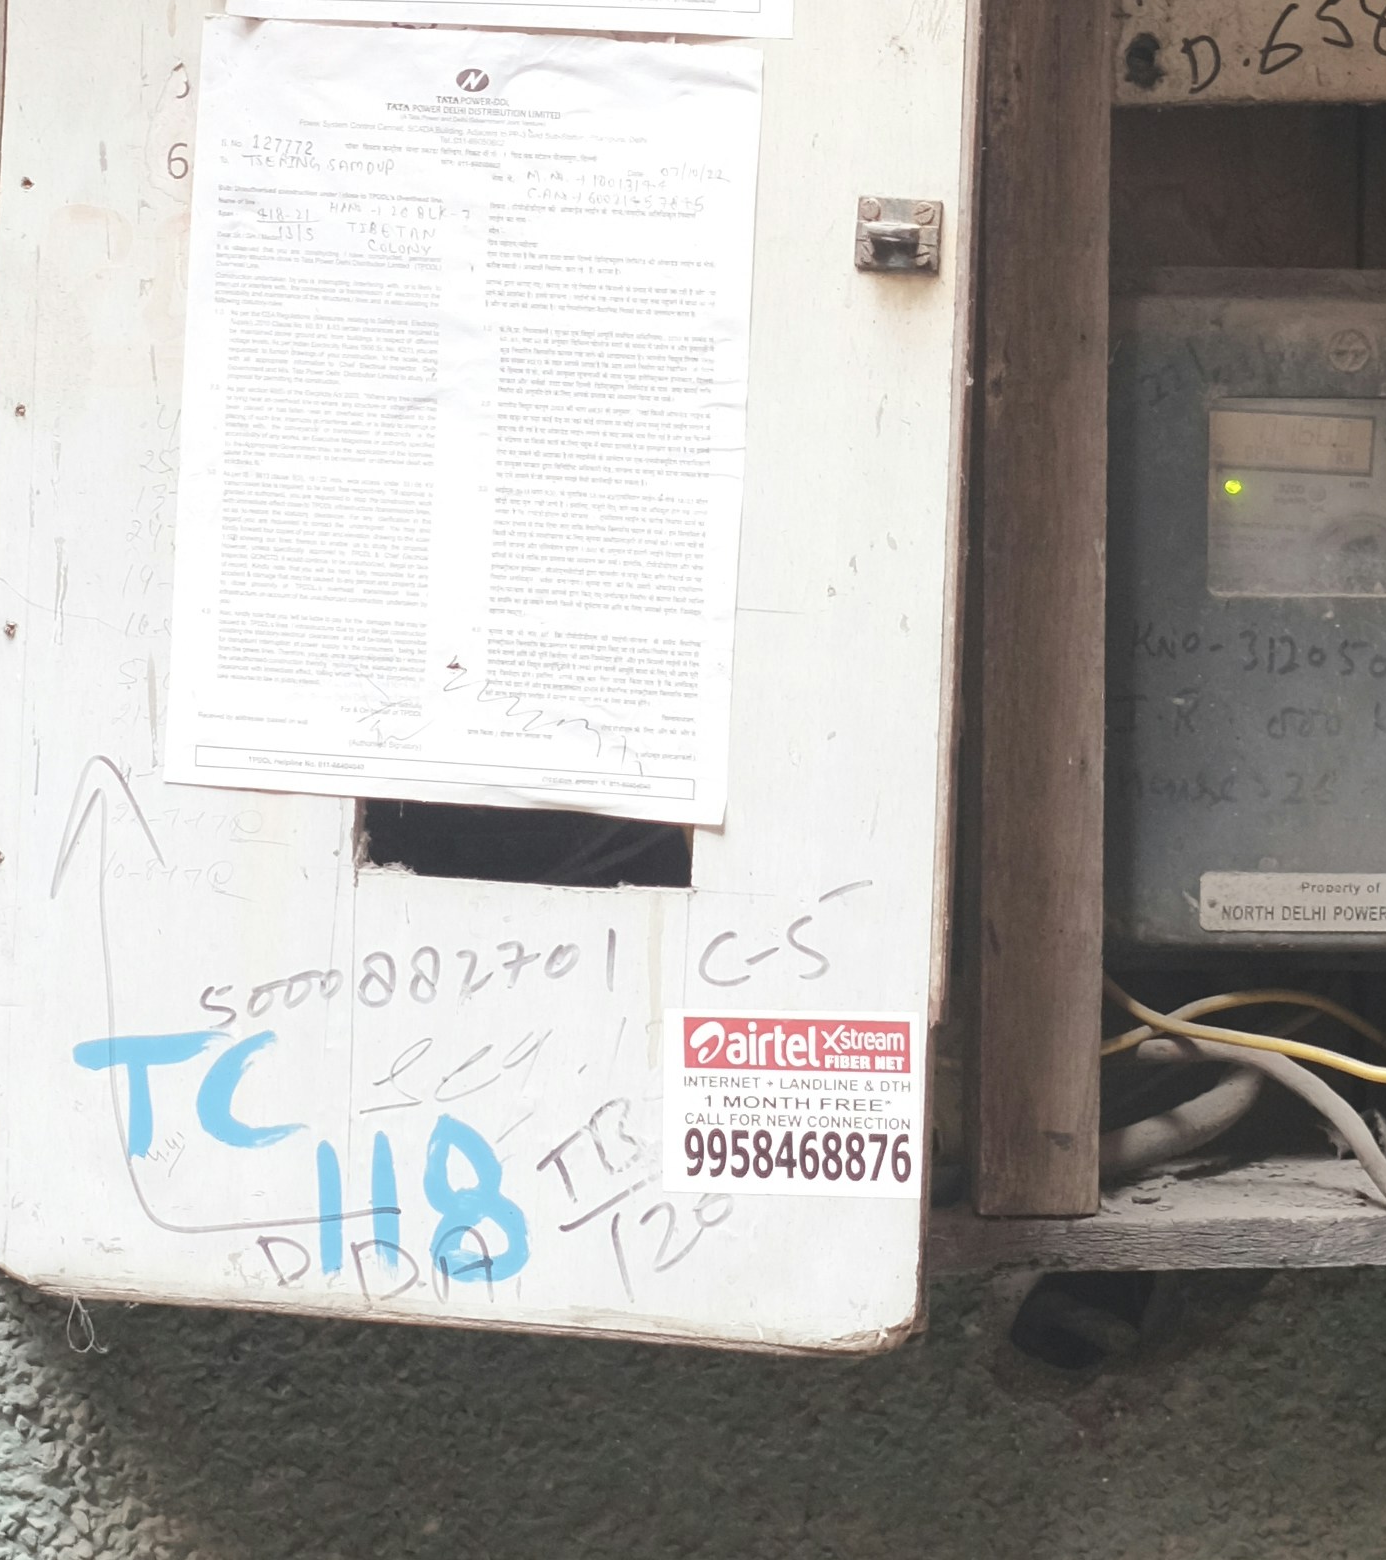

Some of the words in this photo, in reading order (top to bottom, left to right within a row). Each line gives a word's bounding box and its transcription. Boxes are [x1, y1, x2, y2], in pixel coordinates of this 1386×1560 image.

[436, 95, 459, 104] TATA
[386, 102, 410, 112] TATA
[412, 104, 441, 114] POWER
[443, 105, 466, 115] DELHI
[468, 107, 527, 117] DISTRIBUTION
[528, 110, 561, 120] LIMITED
[251, 134, 314, 156] 127772
[166, 141, 190, 180] 6
[346, 221, 436, 240] TIBETAN
[367, 239, 432, 256] COLONY
[1300, 881, 1361, 896] Property
[1366, 881, 1381, 894] of
[1221, 905, 1275, 921] NORTH
[1281, 906, 1327, 921] DELHI
[201, 927, 617, 1030] 5000882701
[725, 1021, 821, 1069] airtel
[821, 1024, 905, 1055] Xstream
[824, 1054, 871, 1070] FIBER
[875, 1055, 905, 1071] NET
[683, 1075, 761, 1089] INTERNET
[779, 1078, 859, 1091] LANDLINE
[864, 1080, 874, 1092] &
[880, 1081, 911, 1093] DTH
[73, 1030, 307, 1158] TC
[704, 1095, 712, 1107] 1
[723, 1095, 810, 1110] MONTH
[684, 1112, 724, 1126] CALL
[729, 1113, 761, 1127] FOR
[766, 1115, 802, 1128] NEW
[807, 1116, 911, 1130] CONNECTION
[684, 1127, 912, 1183] 9958468876
